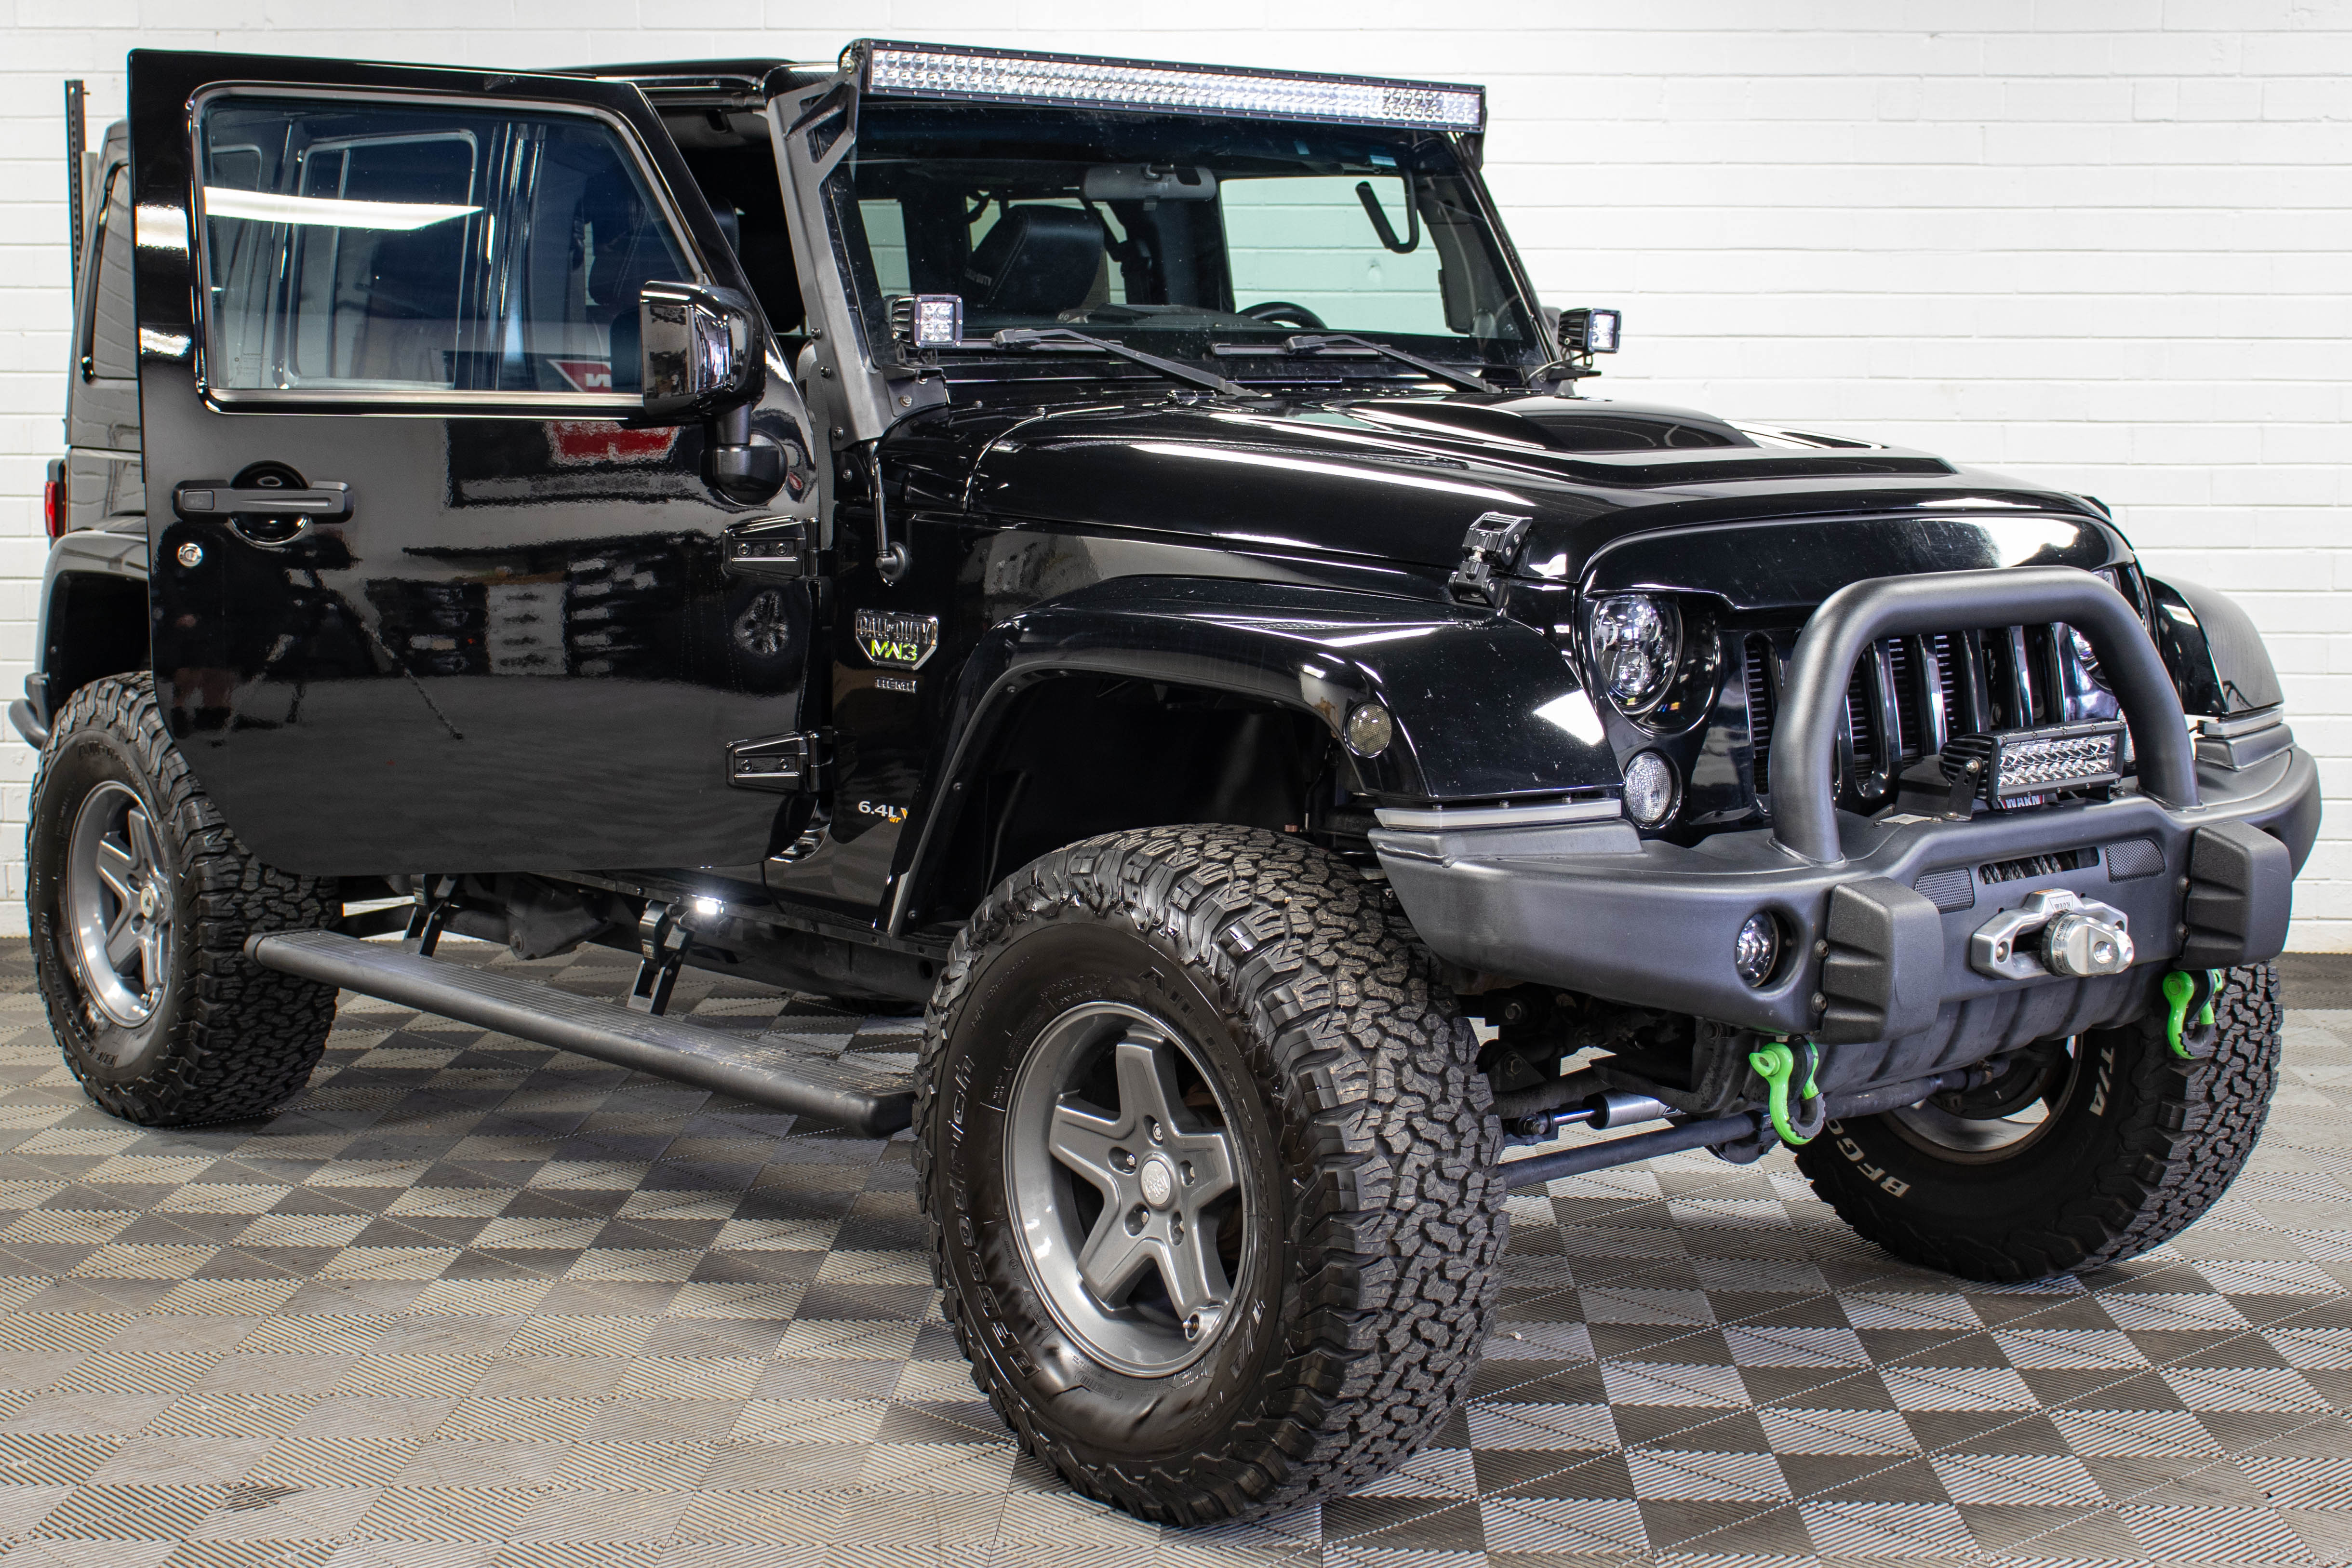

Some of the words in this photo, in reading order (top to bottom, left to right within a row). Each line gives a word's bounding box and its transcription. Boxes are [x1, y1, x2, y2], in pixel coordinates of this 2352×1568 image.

[858, 801, 897, 818] 6.4L
[2088, 1047, 2115, 1117] T/A
[947, 1055, 1042, 1380] BFGoodrich
